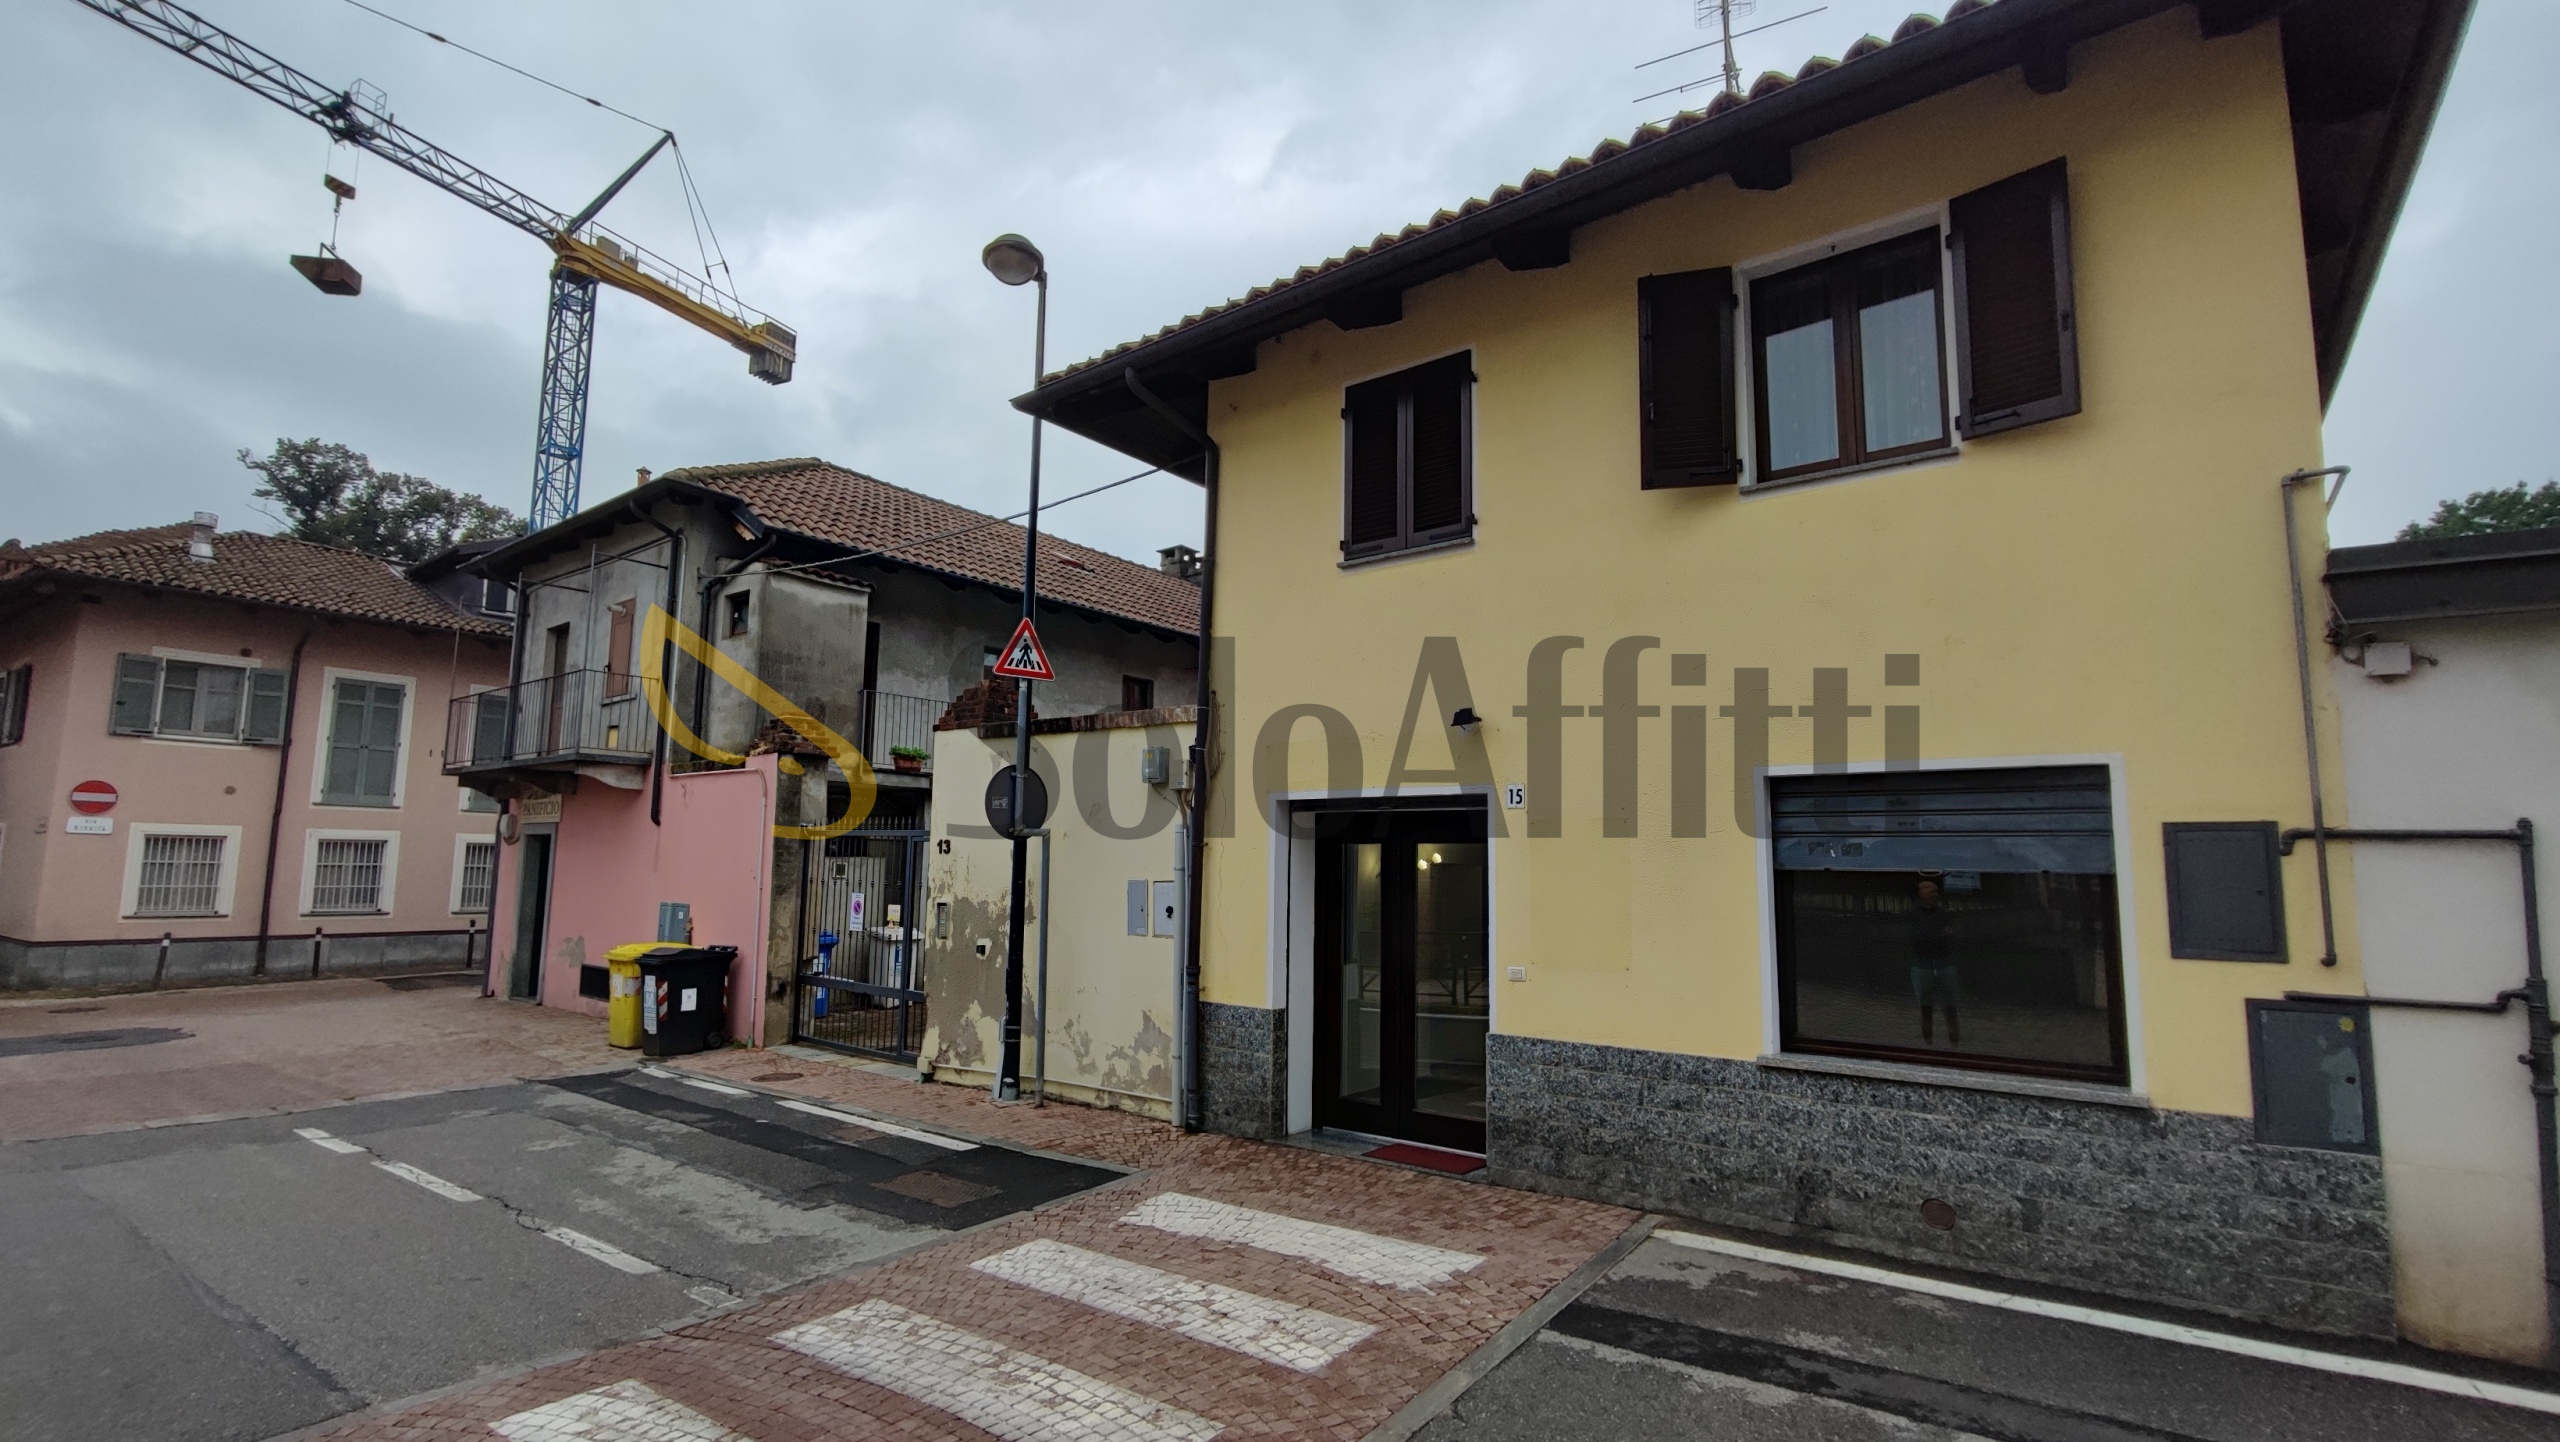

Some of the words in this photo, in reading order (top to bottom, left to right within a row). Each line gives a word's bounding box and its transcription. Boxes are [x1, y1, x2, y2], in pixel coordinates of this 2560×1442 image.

[1509, 788, 1523, 805] 15
[522, 800, 560, 817] PANIFICIO
[936, 839, 951, 855] 13
